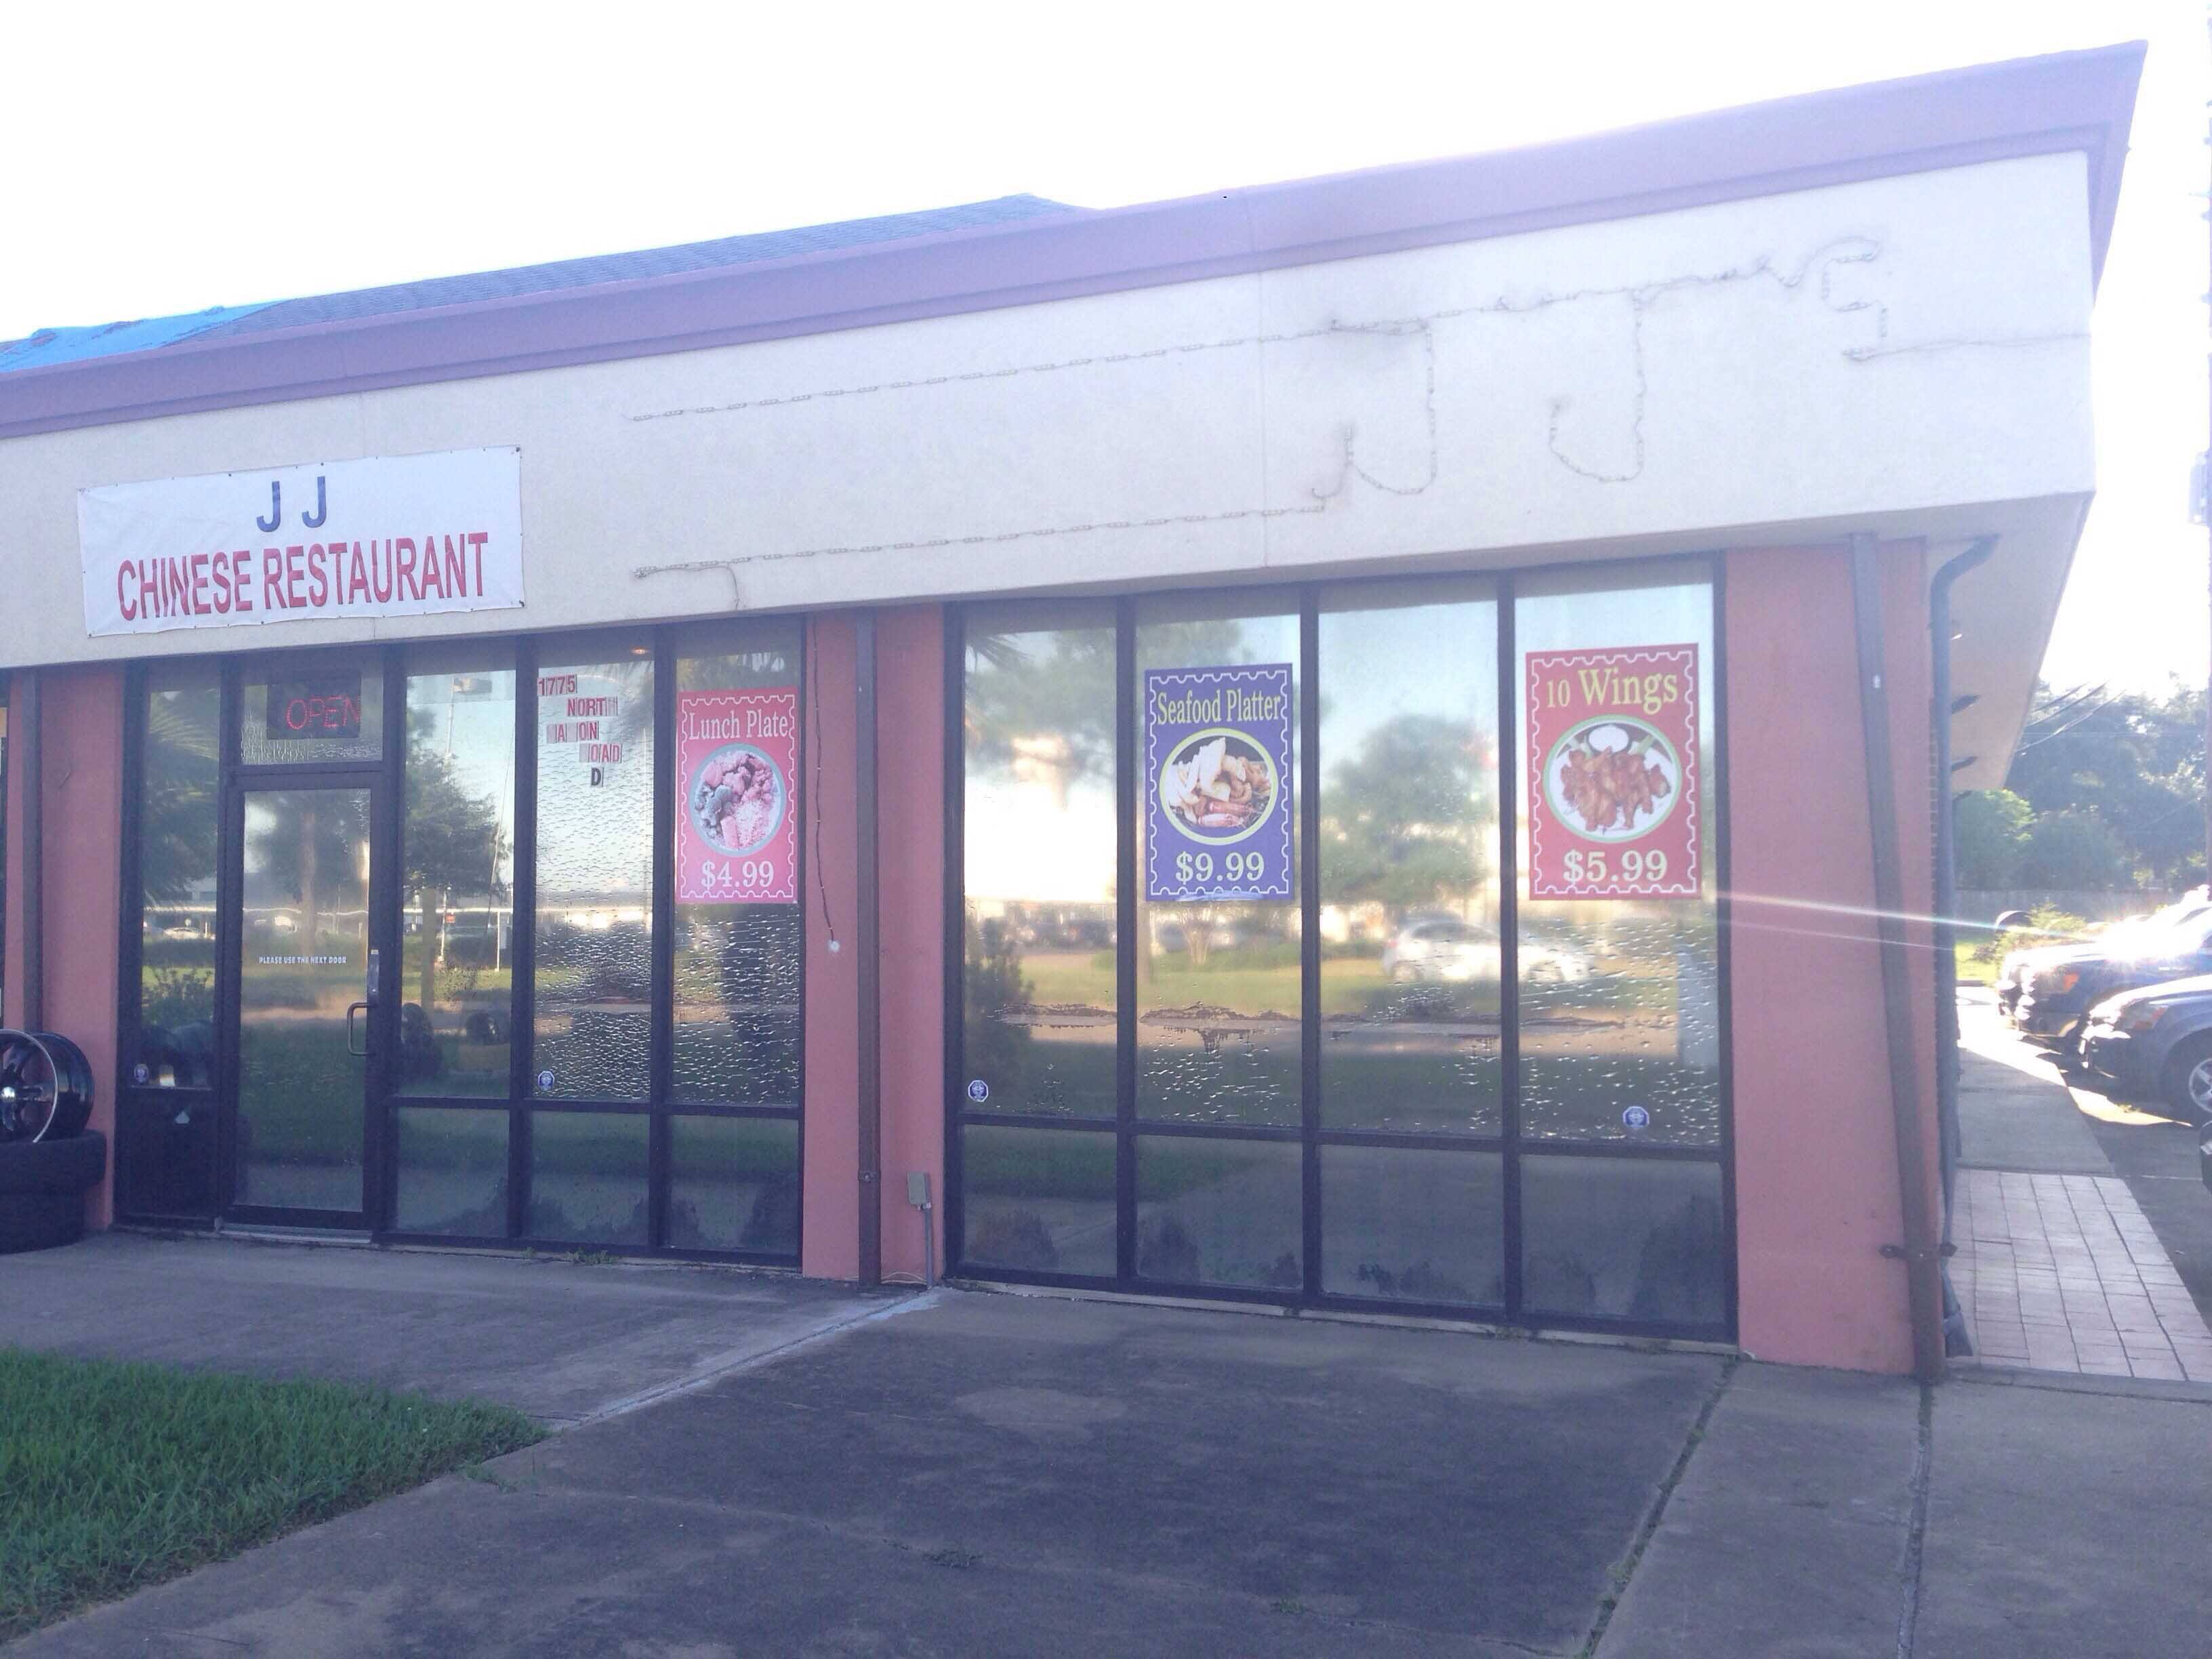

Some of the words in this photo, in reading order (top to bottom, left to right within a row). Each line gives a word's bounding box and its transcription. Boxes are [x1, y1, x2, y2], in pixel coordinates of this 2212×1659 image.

[255, 480, 281, 533] J
[302, 476, 326, 528] J
[117, 550, 253, 621] CHINESE
[263, 531, 489, 609] RESTAURANT
[1157, 689, 1222, 725] Seafood
[1227, 688, 1281, 722] Platter
[1546, 679, 1571, 708] 10
[1578, 666, 1678, 716] Wings
[285, 693, 362, 730] OPEN
[689, 710, 740, 740] Lunch
[747, 707, 788, 738] Plate
[579, 743, 620, 763] OAD
[701, 859, 775, 890] $4.99
[1174, 851, 1265, 885] $9.99
[1563, 849, 1668, 886] $5.99
[258, 956, 283, 964] PLEASE
[283, 956, 295, 964] USE
[297, 956, 309, 964] THE
[310, 956, 327, 964] NEXT
[329, 956, 347, 964] DOOR
